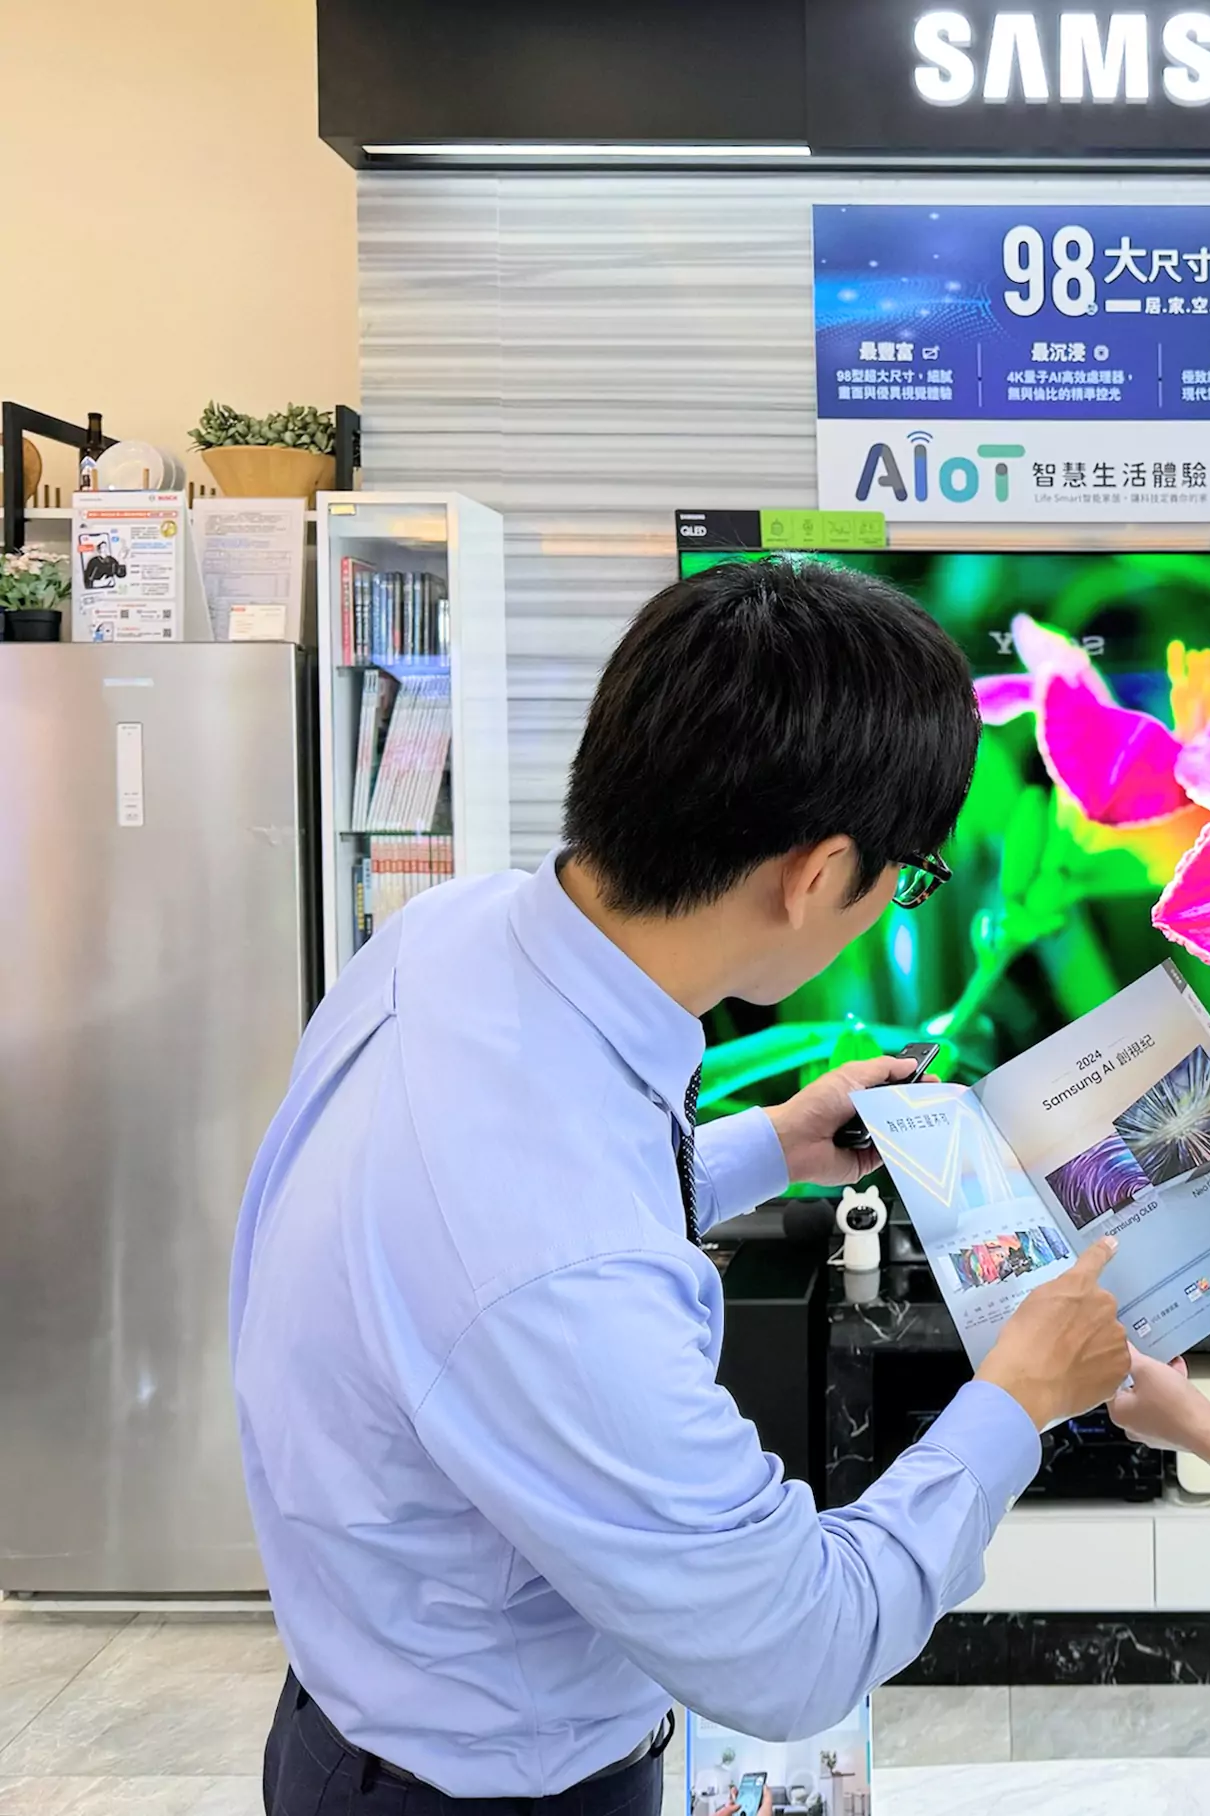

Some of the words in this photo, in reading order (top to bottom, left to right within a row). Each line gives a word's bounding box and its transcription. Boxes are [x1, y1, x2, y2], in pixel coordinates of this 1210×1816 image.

[858, 341, 915, 363] 最豐富
[1030, 342, 1087, 363] 最沉浸
[855, 442, 1026, 503] AIoT
[1032, 461, 1208, 489] 智慧生活體驗
[680, 525, 708, 537] QLED
[1075, 1049, 1102, 1071] 2024
[1042, 1070, 1103, 1111] Samsung
[1102, 1060, 1116, 1075] AI
[1192, 1185, 1209, 1198] Neo
[1139, 1201, 1158, 1217] OLED
